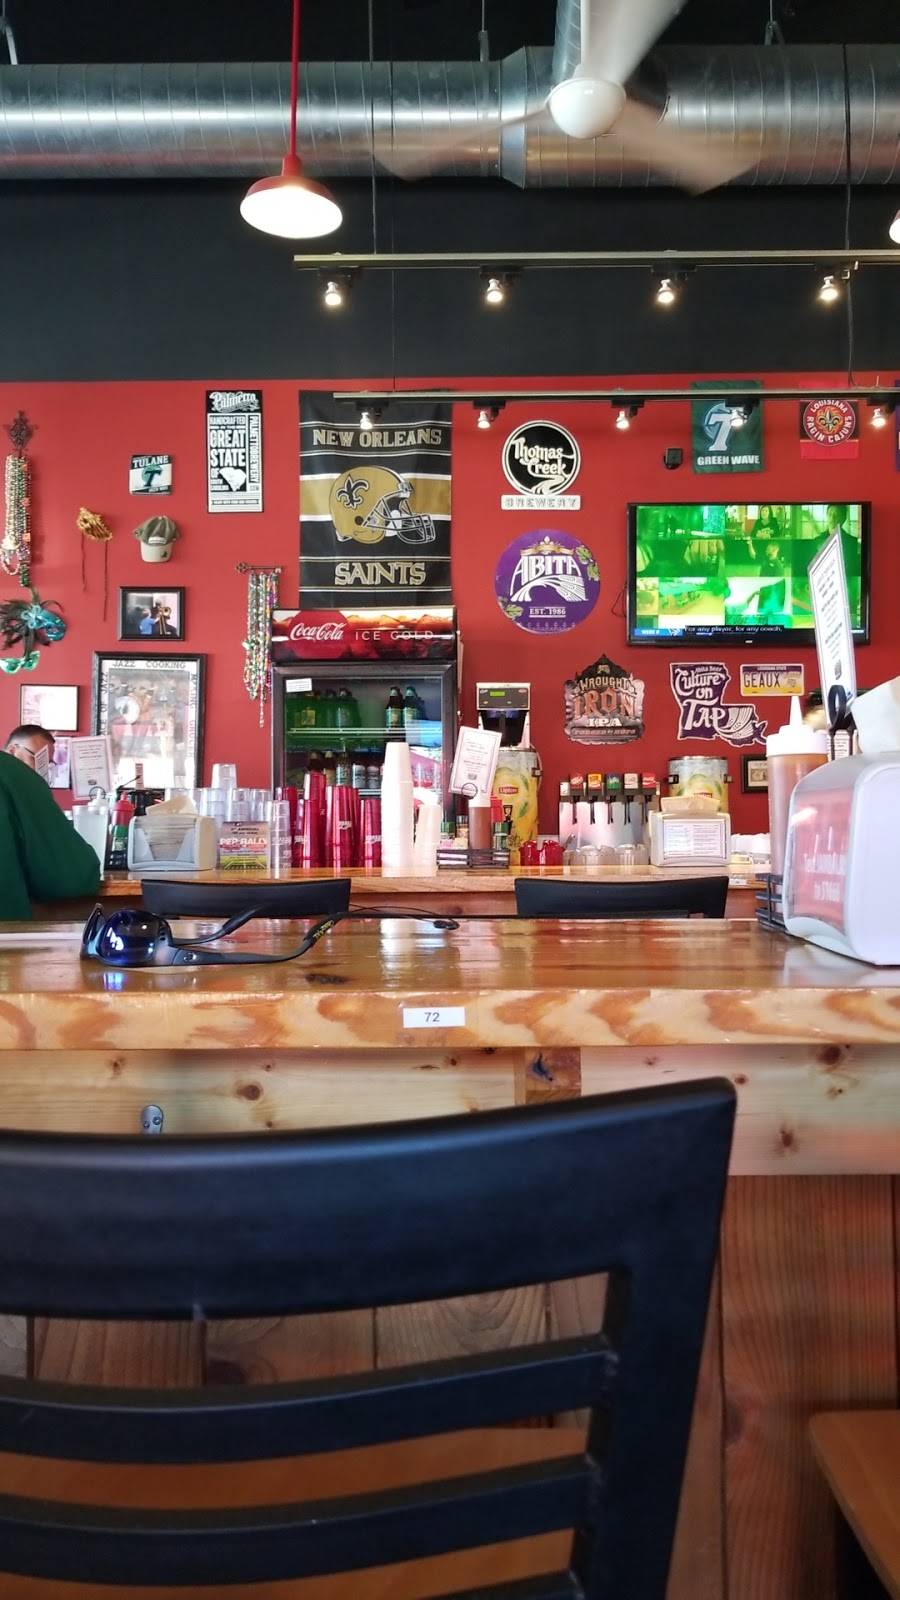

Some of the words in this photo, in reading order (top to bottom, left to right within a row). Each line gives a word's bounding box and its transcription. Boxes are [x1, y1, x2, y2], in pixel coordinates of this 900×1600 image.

[810, 399, 848, 414] LOUISIANA
[210, 430, 246, 448] GREAT
[313, 429, 354, 447] NEW
[359, 428, 442, 448] ORLEANS
[210, 449, 246, 467] STATE
[510, 437, 565, 463] Thomas
[132, 456, 169, 468] TULANE
[520, 458, 571, 478] Creek
[697, 456, 729, 466] GREEN
[731, 454, 760, 465] WAVE
[335, 562, 427, 586] SAINTS
[510, 555, 583, 596] ABITA
[290, 622, 348, 642] Coca-Cola
[355, 632, 381, 641] ICE
[145, 661, 186, 669] COOKING
[580, 677, 629, 690] WROUGHT
[675, 668, 725, 696] Culture
[743, 672, 781, 688] GEAUX
[696, 688, 713, 699] on
[574, 688, 635, 720] IRON
[586, 718, 622, 727] IPA
[683, 697, 726, 731] TAP
[424, 1012, 440, 1022] 72
